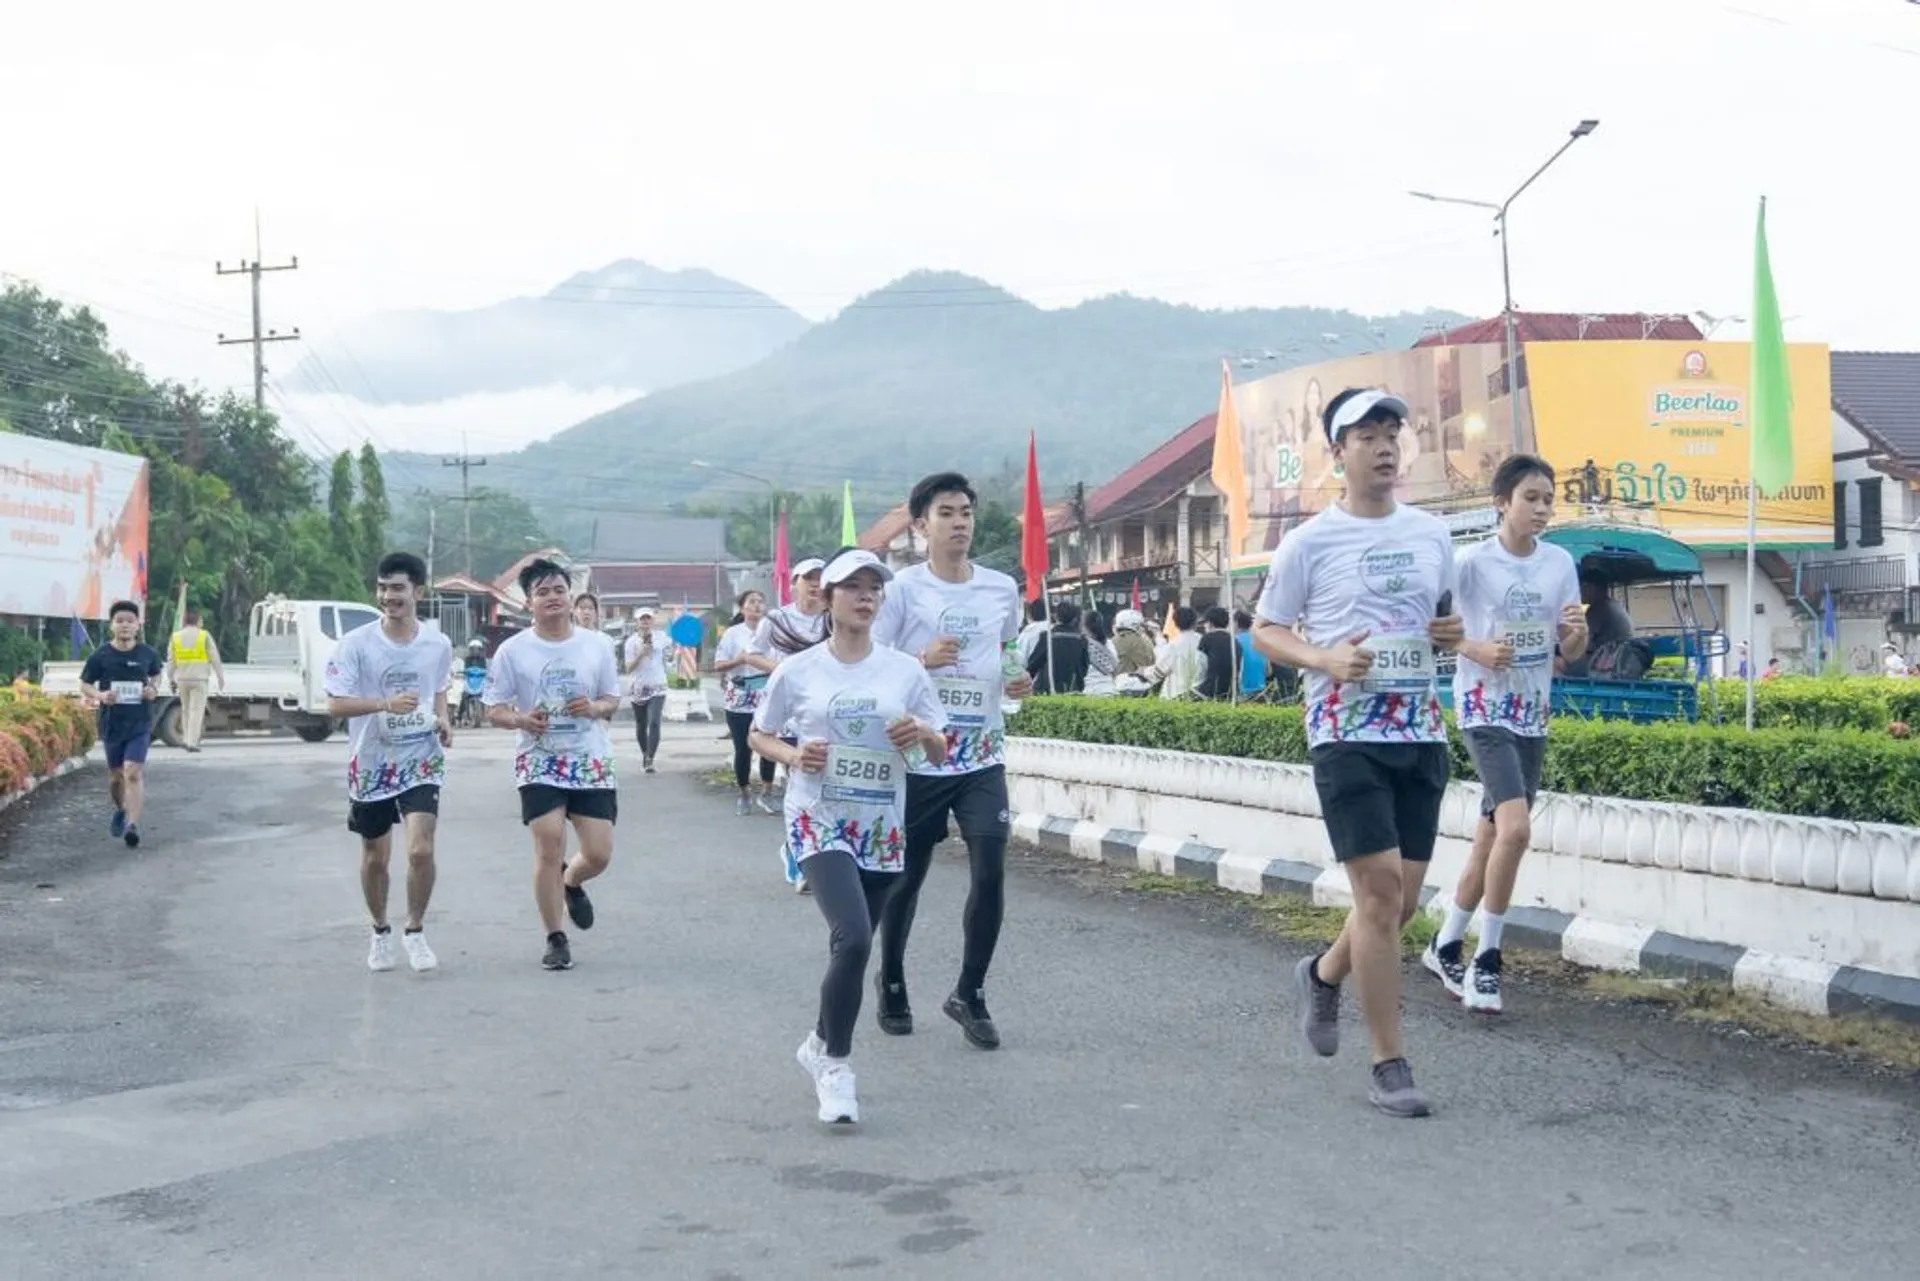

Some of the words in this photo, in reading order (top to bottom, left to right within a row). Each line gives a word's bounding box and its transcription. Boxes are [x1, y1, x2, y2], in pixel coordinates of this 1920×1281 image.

[1655, 391, 1740, 413] Beerlao
[1670, 428, 1725, 437] PREMIUM
[1377, 650, 1421, 668] 5149
[938, 689, 983, 706] 5679
[386, 713, 424, 729] 6445
[835, 758, 891, 780] 5288
